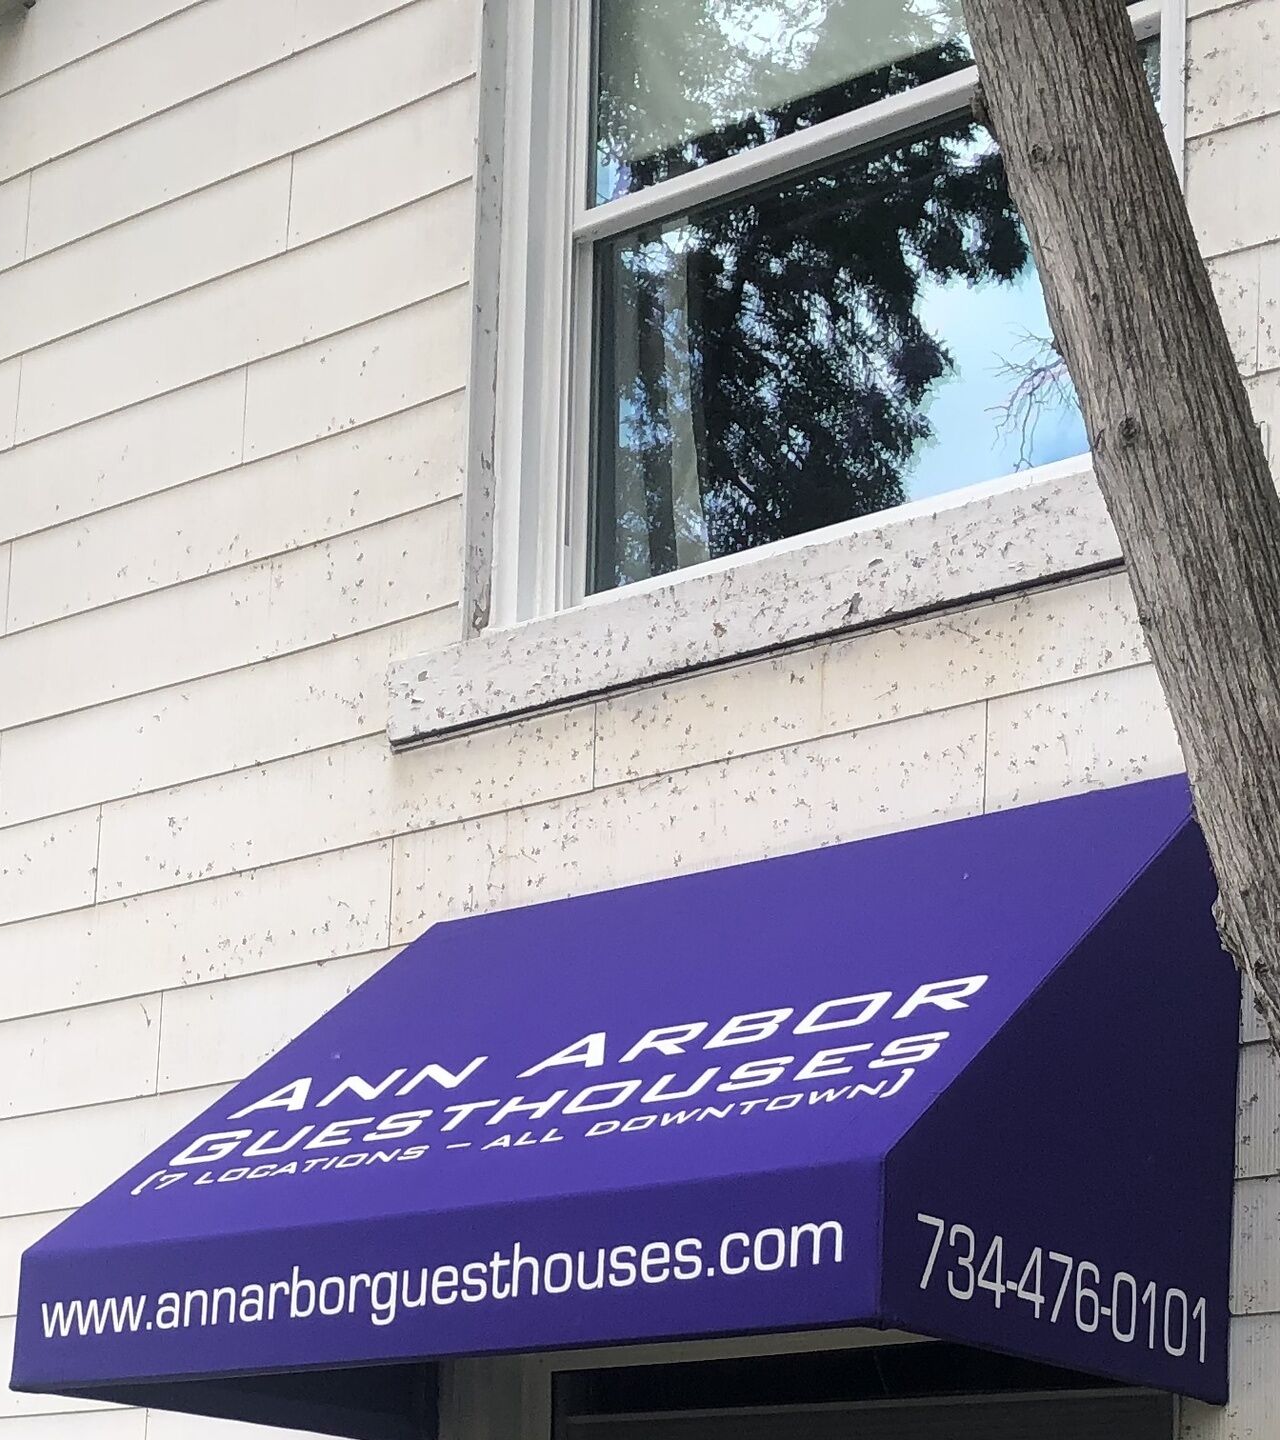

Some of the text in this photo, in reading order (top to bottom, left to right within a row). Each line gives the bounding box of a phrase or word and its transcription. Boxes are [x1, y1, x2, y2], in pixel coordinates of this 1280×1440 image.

[168, 1031, 950, 1167] GUESTHOUSES
[226, 974, 989, 1120] ANN ARBOR
[130, 1169, 188, 1196] (7
[193, 1144, 430, 1186] LOCATIONS
[480, 1128, 564, 1151] ALL
[584, 1067, 915, 1137] DOWNTOWN)
[41, 1220, 843, 1338] www.annarborguesthouses.com
[917, 1213, 1206, 1364] 734-476-0101
